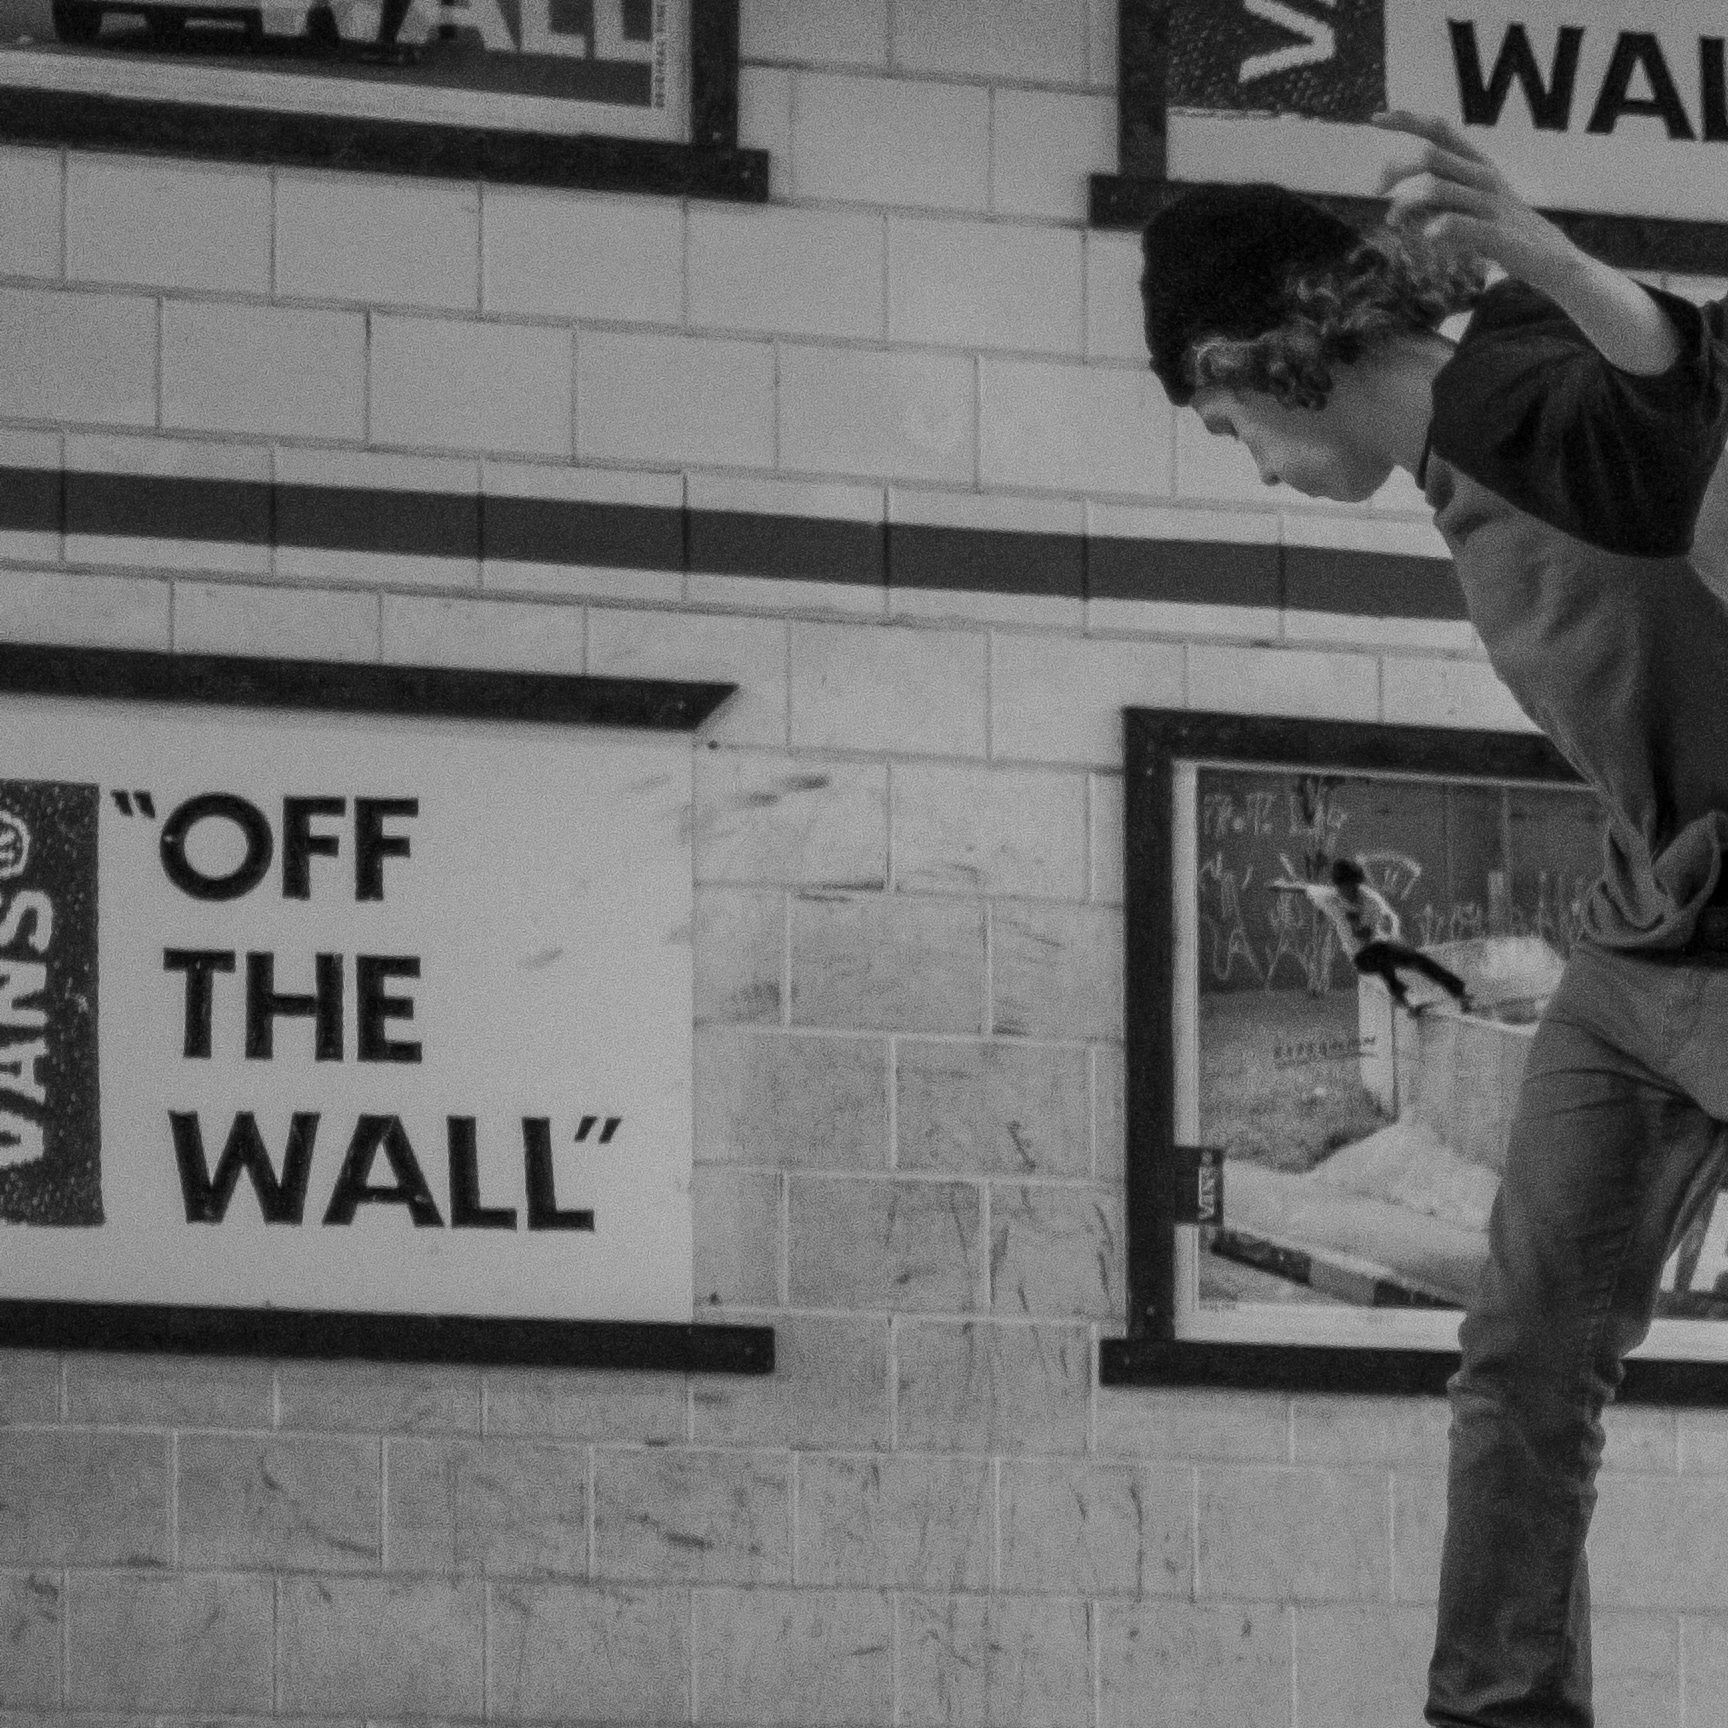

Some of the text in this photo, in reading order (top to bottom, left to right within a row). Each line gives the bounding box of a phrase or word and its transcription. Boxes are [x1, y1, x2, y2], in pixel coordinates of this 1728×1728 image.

[111, 789, 420, 902] "OFF
[163, 947, 423, 1063] THE
[168, 1110, 623, 1232] WALL"
